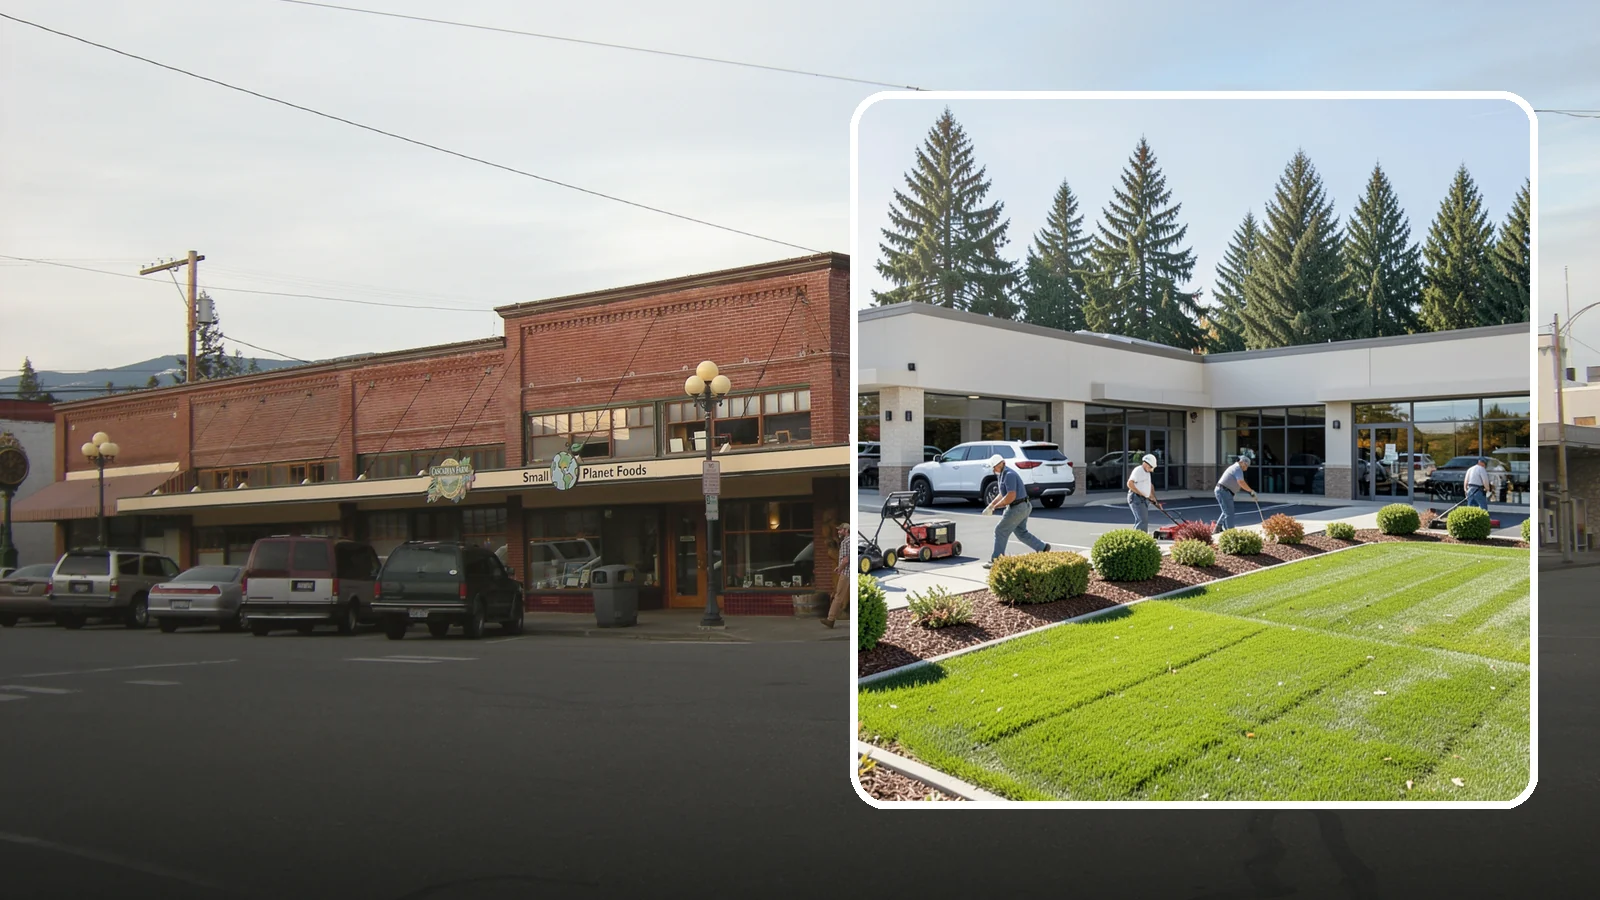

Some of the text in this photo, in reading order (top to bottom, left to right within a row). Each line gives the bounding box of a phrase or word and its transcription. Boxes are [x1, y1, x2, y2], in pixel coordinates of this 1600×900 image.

[523, 464, 647, 483] Small Planet Foods
